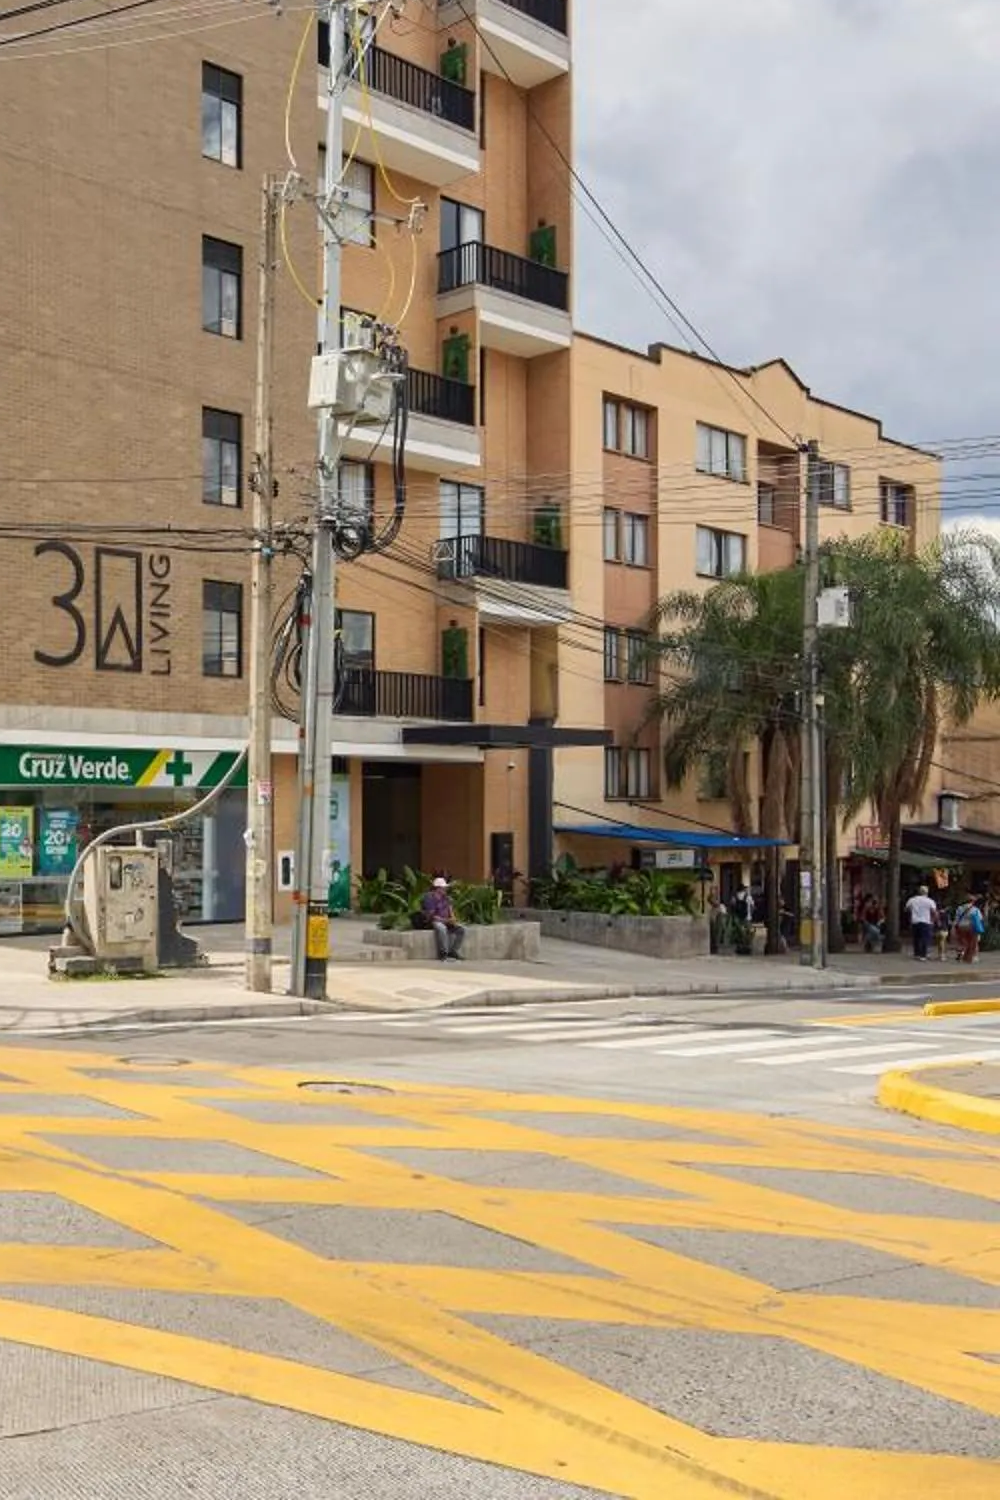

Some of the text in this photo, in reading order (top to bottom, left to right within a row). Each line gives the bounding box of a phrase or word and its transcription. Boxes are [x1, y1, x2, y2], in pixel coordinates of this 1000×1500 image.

[150, 554, 171, 676] LIVING
[19, 751, 129, 780] Cruz Verde
